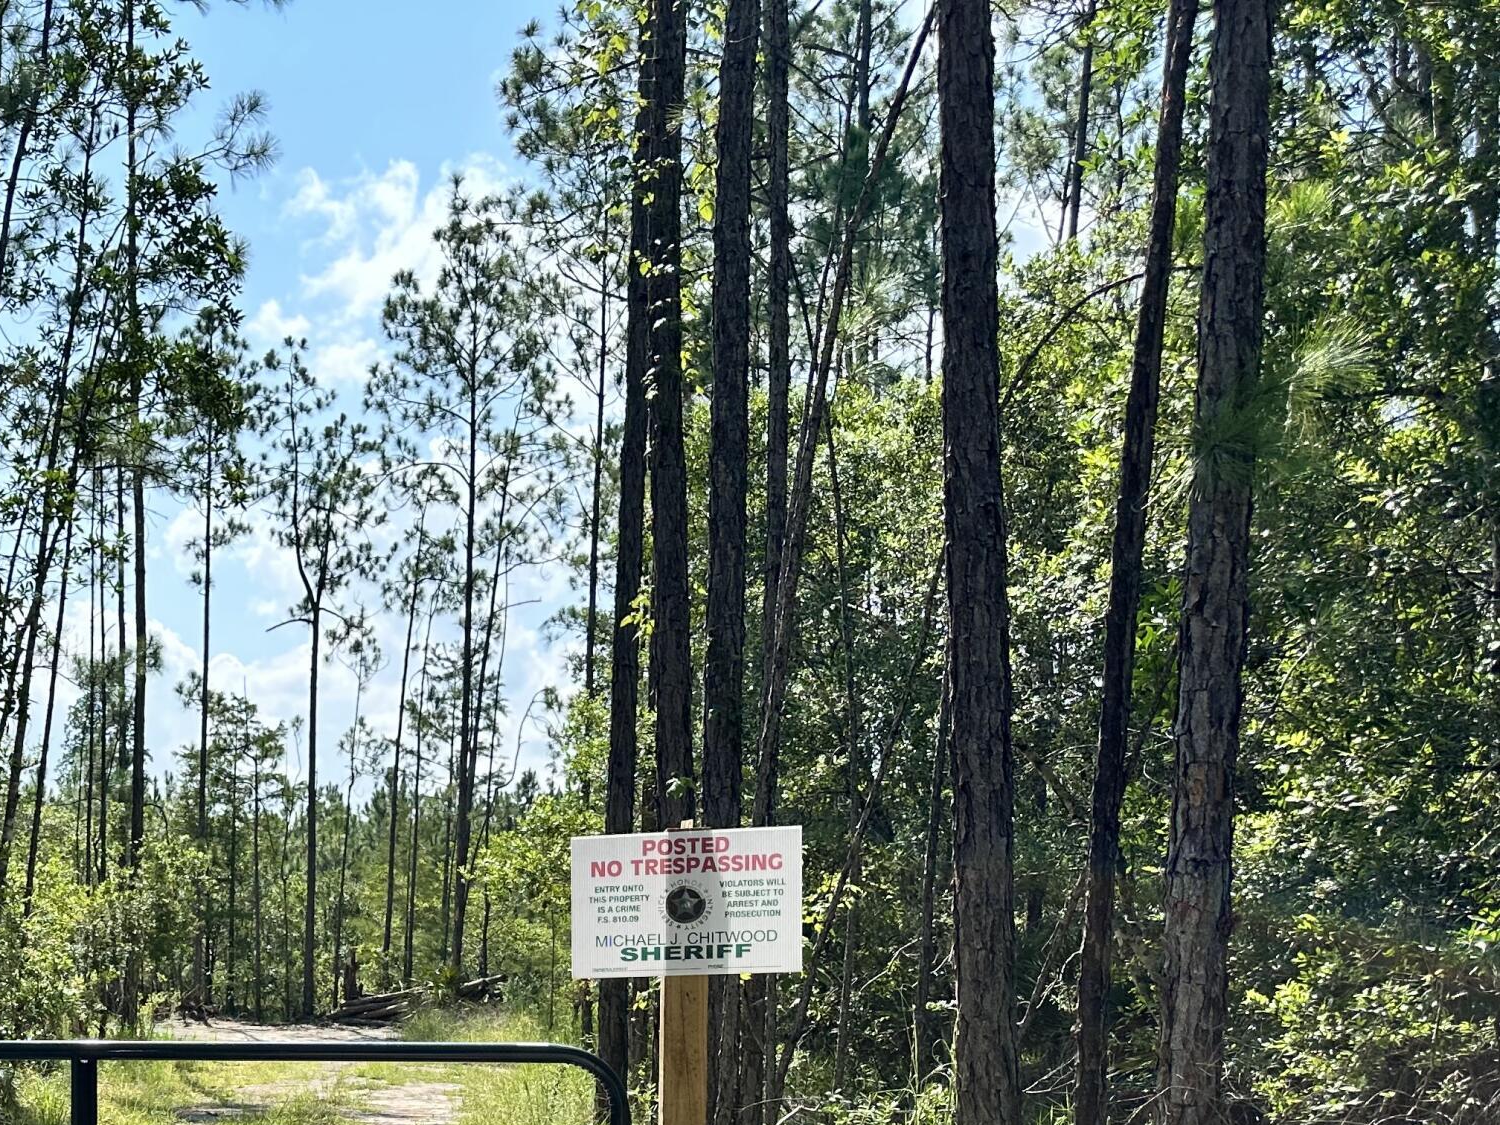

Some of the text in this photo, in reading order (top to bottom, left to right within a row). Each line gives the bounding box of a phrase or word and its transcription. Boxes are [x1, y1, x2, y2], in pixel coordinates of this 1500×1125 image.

[642, 837, 730, 856] POSTED
[590, 853, 783, 877] NO TRESPASSING
[719, 878, 786, 887] VIOLATORS WILL
[594, 885, 620, 893] ENTRY
[721, 888, 784, 898] BE SUBJECT TO
[609, 895, 650, 903] PROPERTY
[727, 899, 779, 908] ARREST AND
[615, 905, 641, 913] CRIME
[724, 909, 781, 918] PROSECUTION
[597, 915, 639, 924] F.S. 810.09
[595, 929, 778, 948] MICHAEL J. CHITWOOD
[620, 943, 752, 962] SHERIFF
